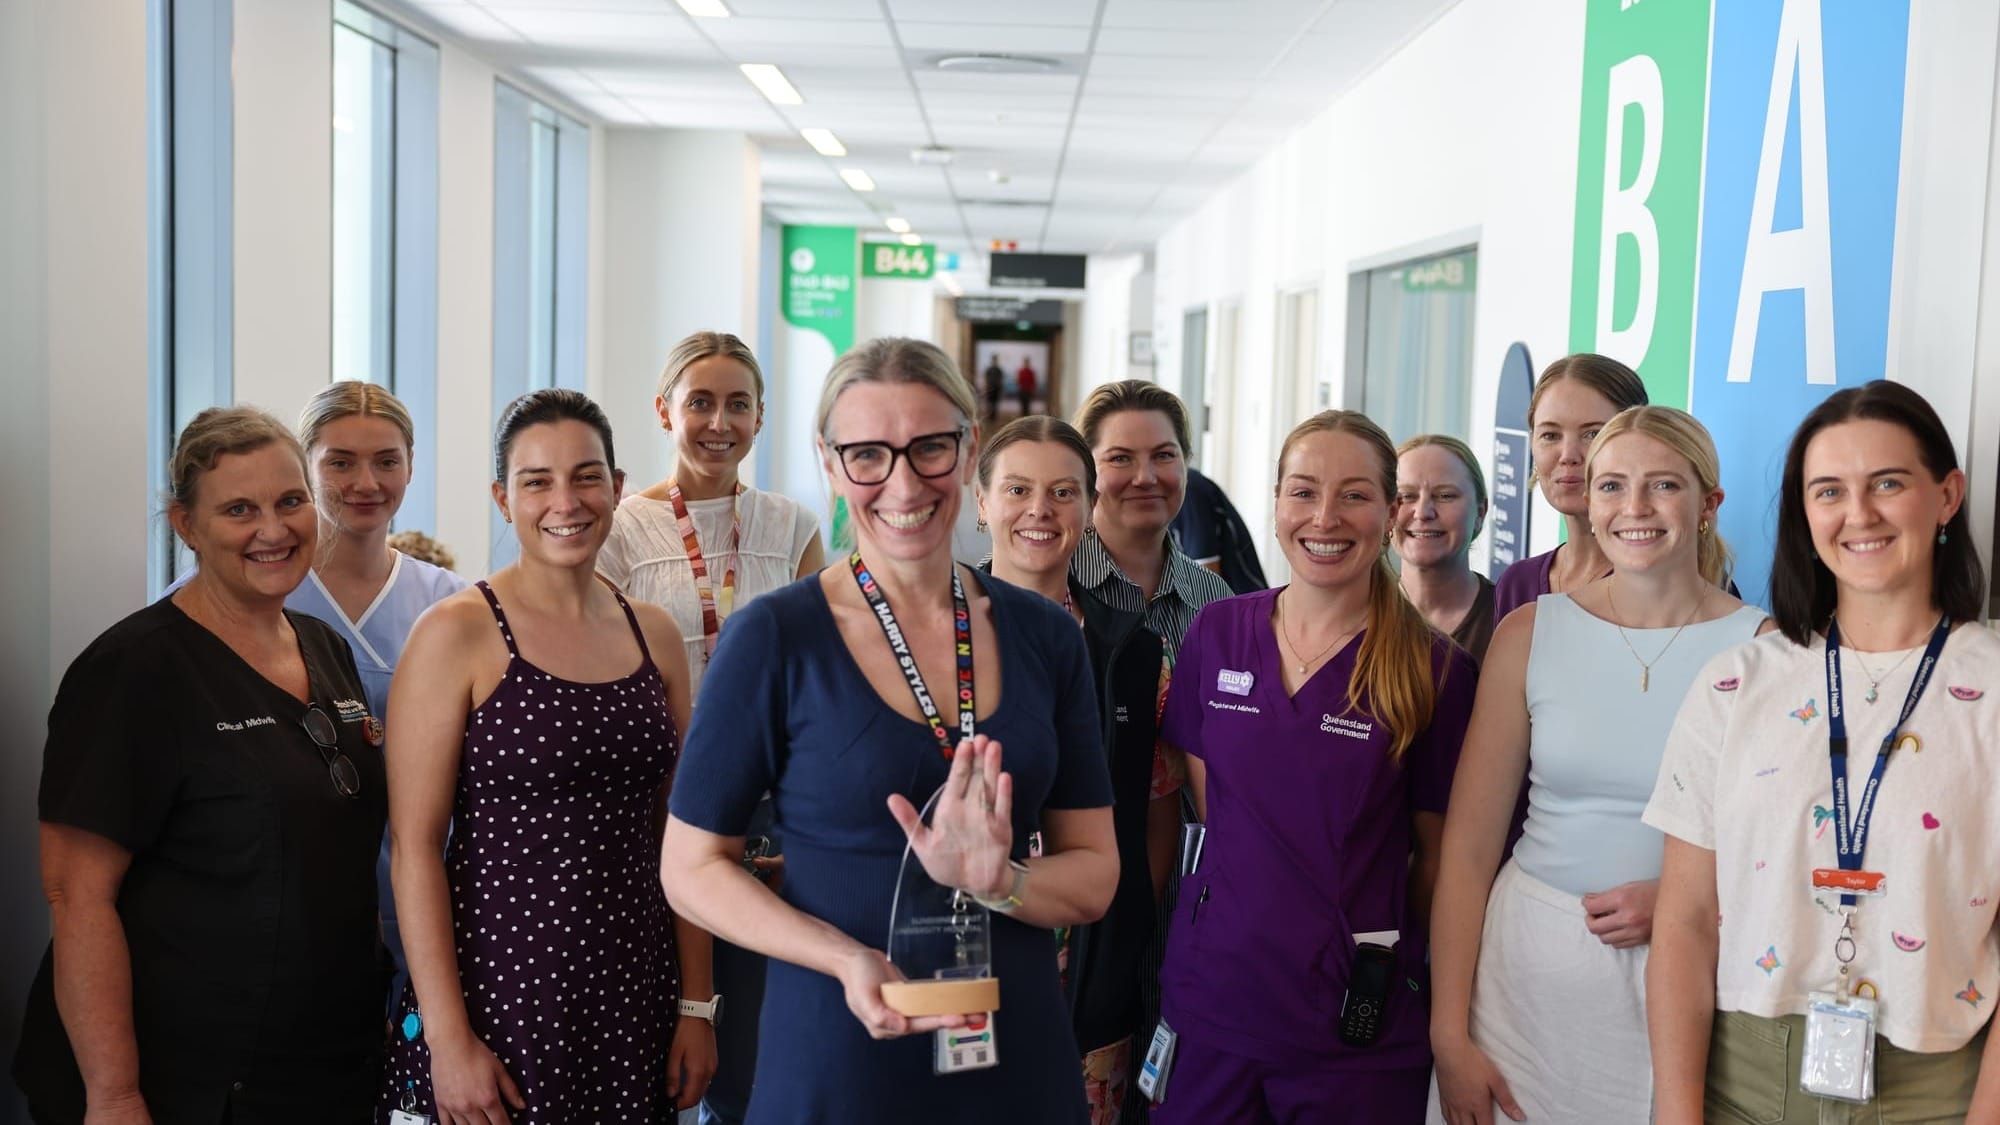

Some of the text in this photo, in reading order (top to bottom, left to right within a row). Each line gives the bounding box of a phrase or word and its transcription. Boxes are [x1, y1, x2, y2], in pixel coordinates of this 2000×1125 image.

[1595, 54, 1664, 373] B
[1726, 0, 1837, 385] A
[874, 246, 929, 274] B44
[856, 562, 882, 602] TOUR
[874, 602, 909, 655] HARRY
[900, 656, 936, 717] STYLES
[955, 600, 970, 641] TOUR
[960, 669, 973, 711] LOVE
[1829, 650, 1841, 718] Queensland Health
[1320, 722, 1370, 740] Government
[1322, 713, 1372, 731] Queensland
[1836, 777, 1849, 855] Queensland Health
[1852, 778, 1878, 855] Queensland Health
